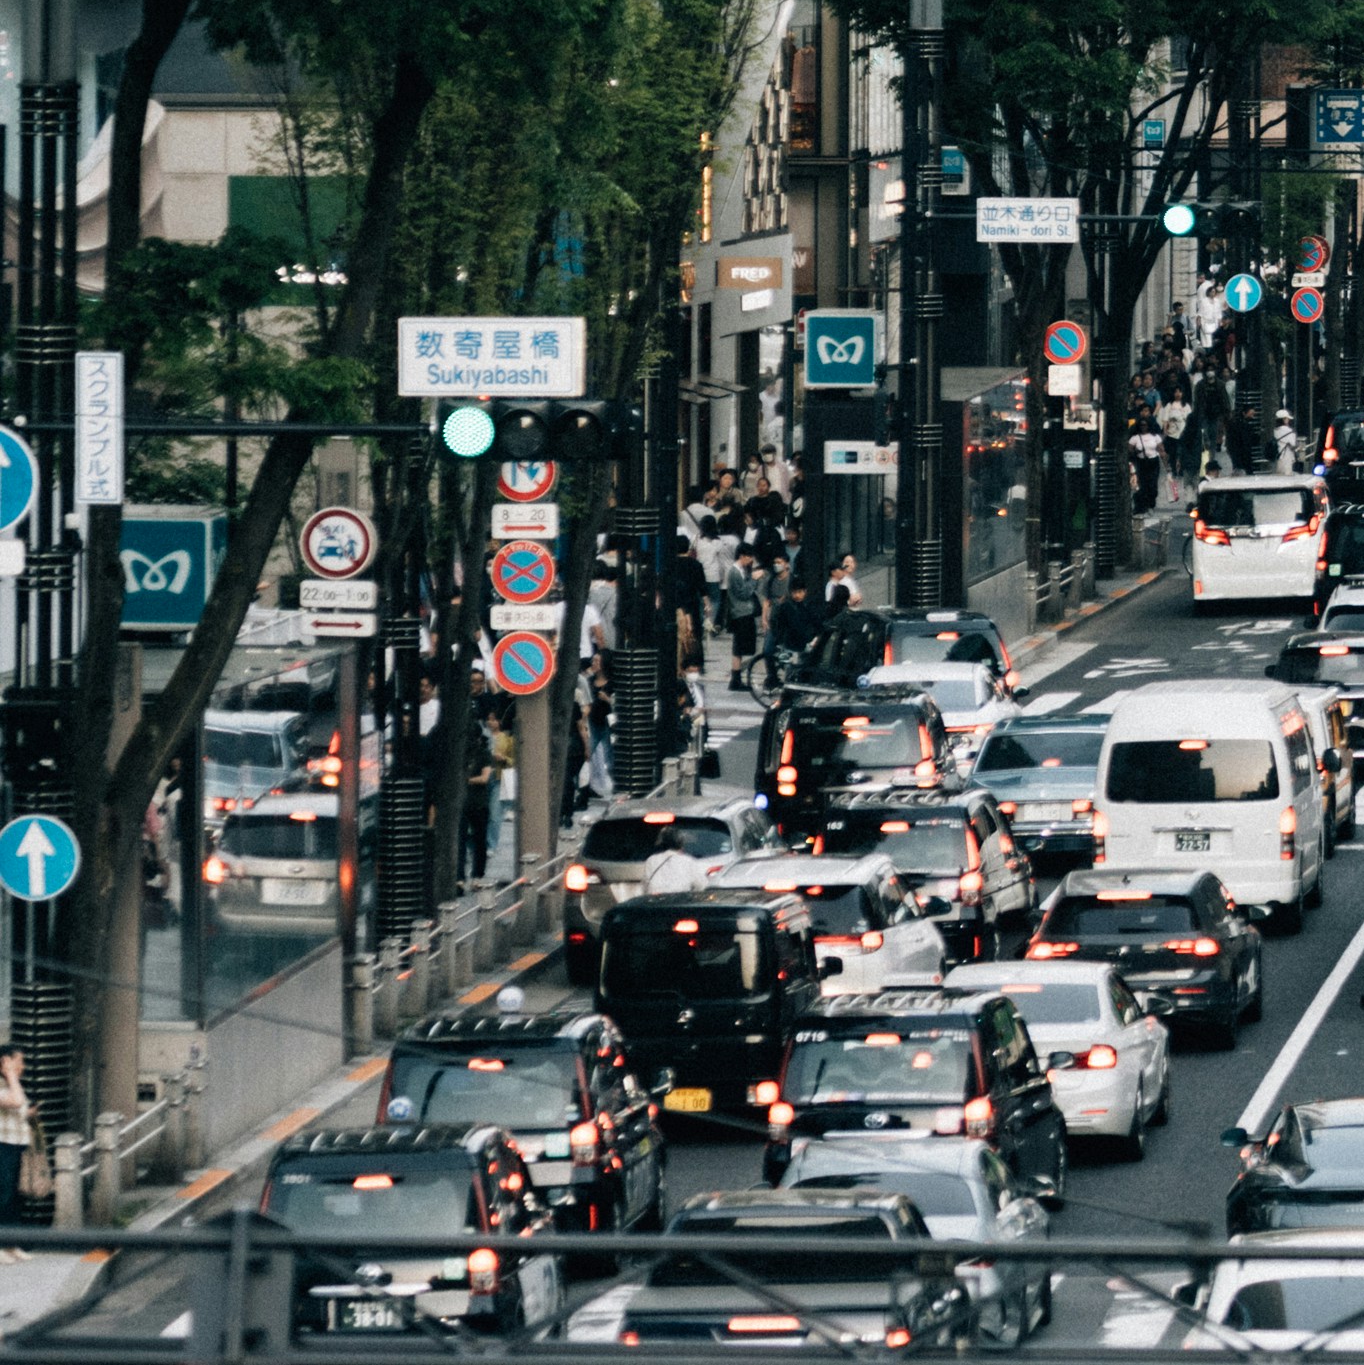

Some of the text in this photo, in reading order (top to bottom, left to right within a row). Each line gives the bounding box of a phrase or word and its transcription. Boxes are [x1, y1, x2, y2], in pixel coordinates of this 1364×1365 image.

[982, 205, 1071, 222] 並木通り口
[730, 267, 771, 282] FRED
[415, 330, 562, 360] 数寄屋橋
[427, 363, 548, 389] Sukiyabashi
[87, 359, 111, 498] スクランブル式
[795, 1031, 827, 1042] 6719
